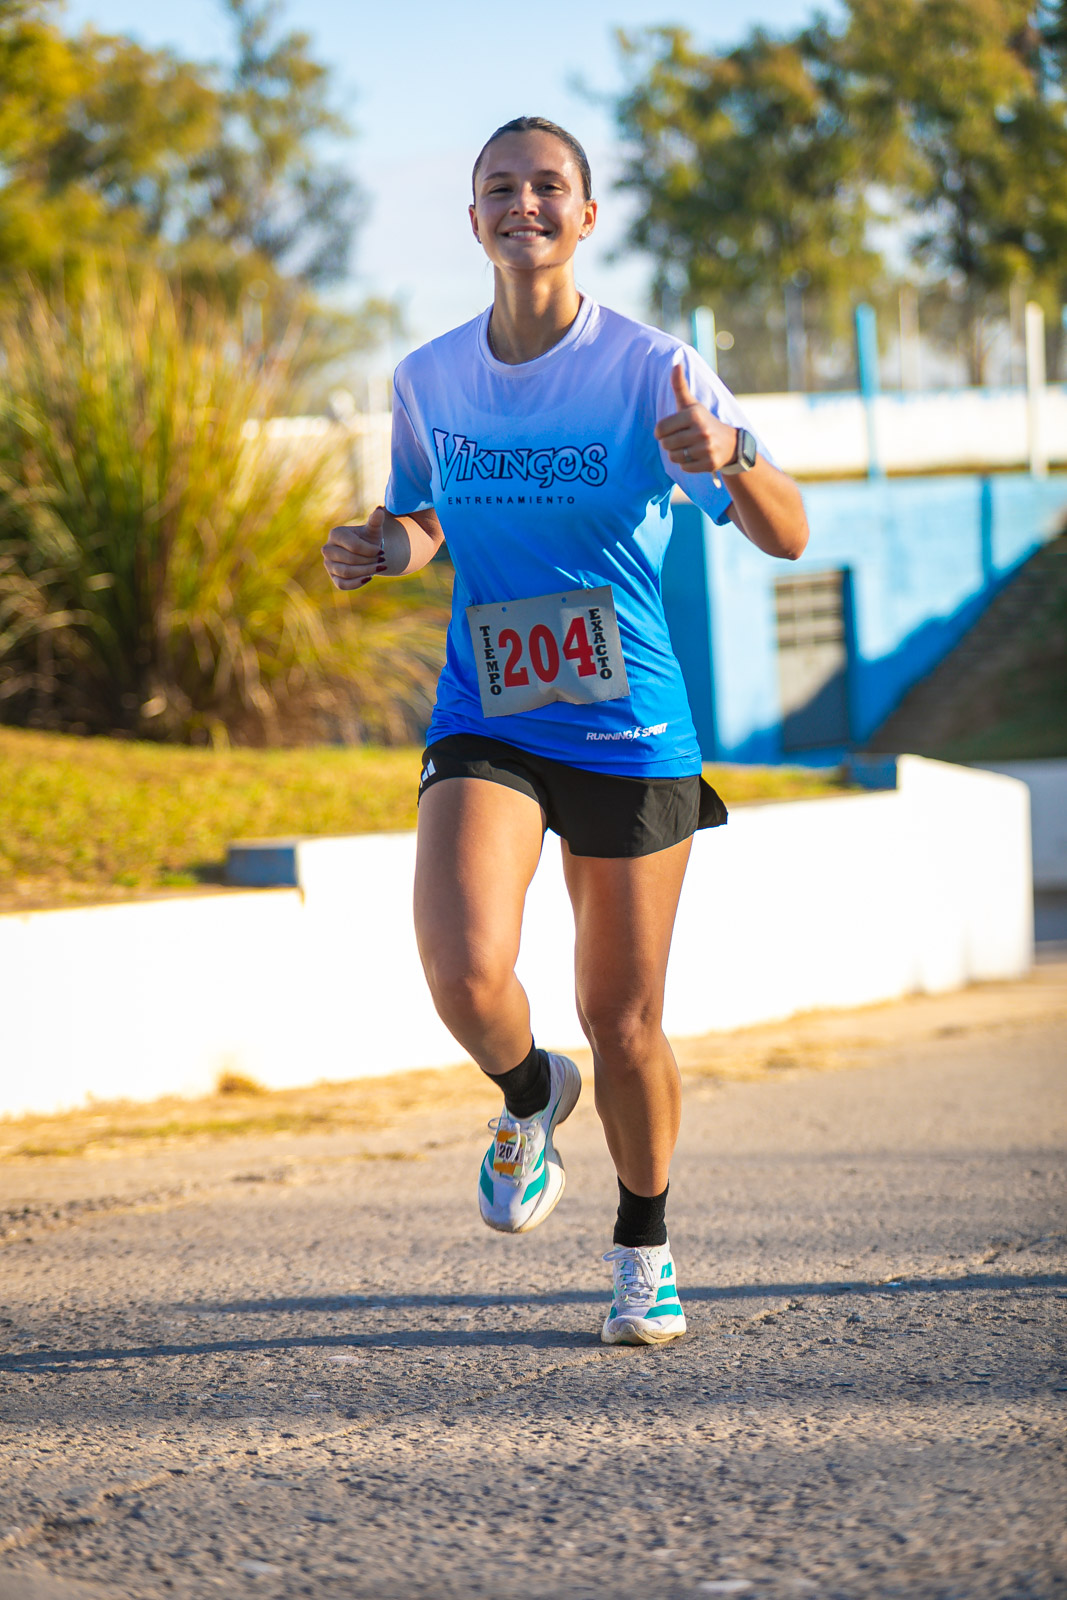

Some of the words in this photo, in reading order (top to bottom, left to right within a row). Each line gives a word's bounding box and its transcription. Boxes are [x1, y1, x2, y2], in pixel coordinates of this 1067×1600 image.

[448, 496, 576, 504] ENTRENAMIENTO
[479, 625, 502, 696] TIEMPO
[498, 616, 597, 688] 204
[588, 608, 613, 680] EXACTO
[586, 730, 633, 740] RUNNING
